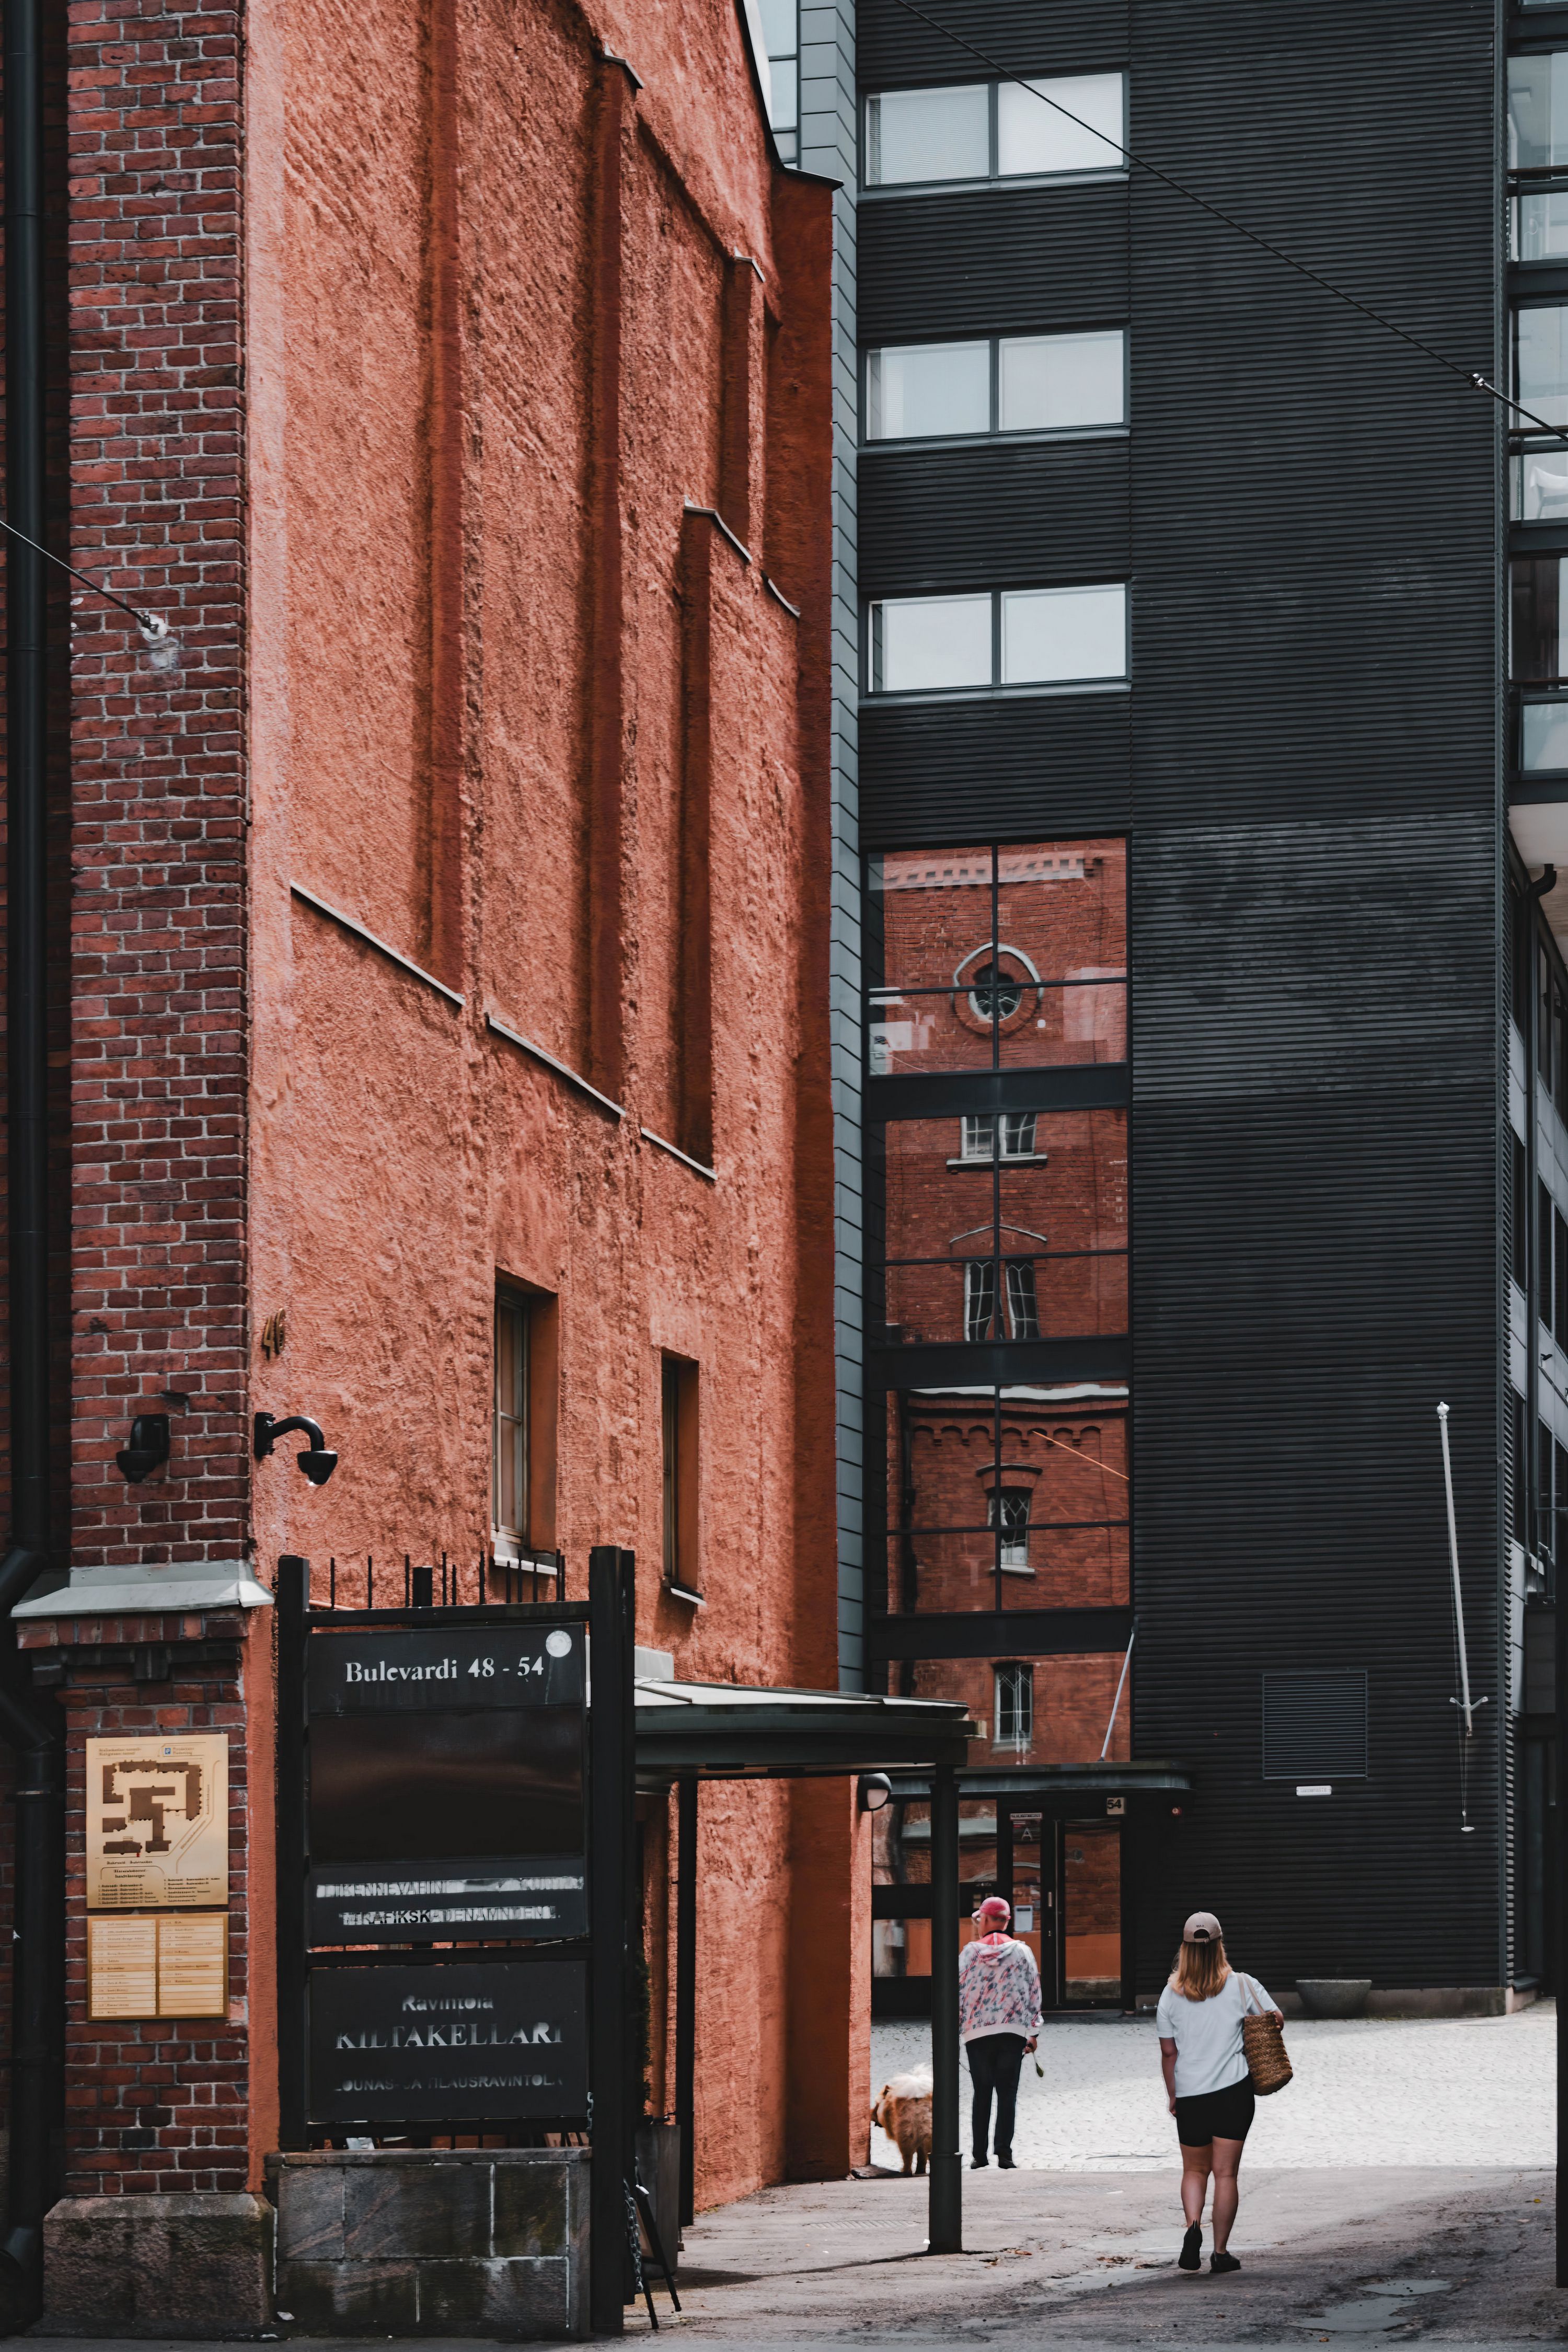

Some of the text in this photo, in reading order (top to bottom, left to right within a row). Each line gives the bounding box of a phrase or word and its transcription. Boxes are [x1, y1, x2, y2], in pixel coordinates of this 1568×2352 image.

[345, 1658, 457, 1682] Bulevardi
[467, 1657, 495, 1678] 48
[517, 1656, 544, 1676] 54
[1108, 1799, 1122, 1809] 54
[1021, 1827, 1033, 1841] A
[335, 2021, 563, 2049] KILTAKELLARI
[335, 2079, 398, 2092] OUNAS-
